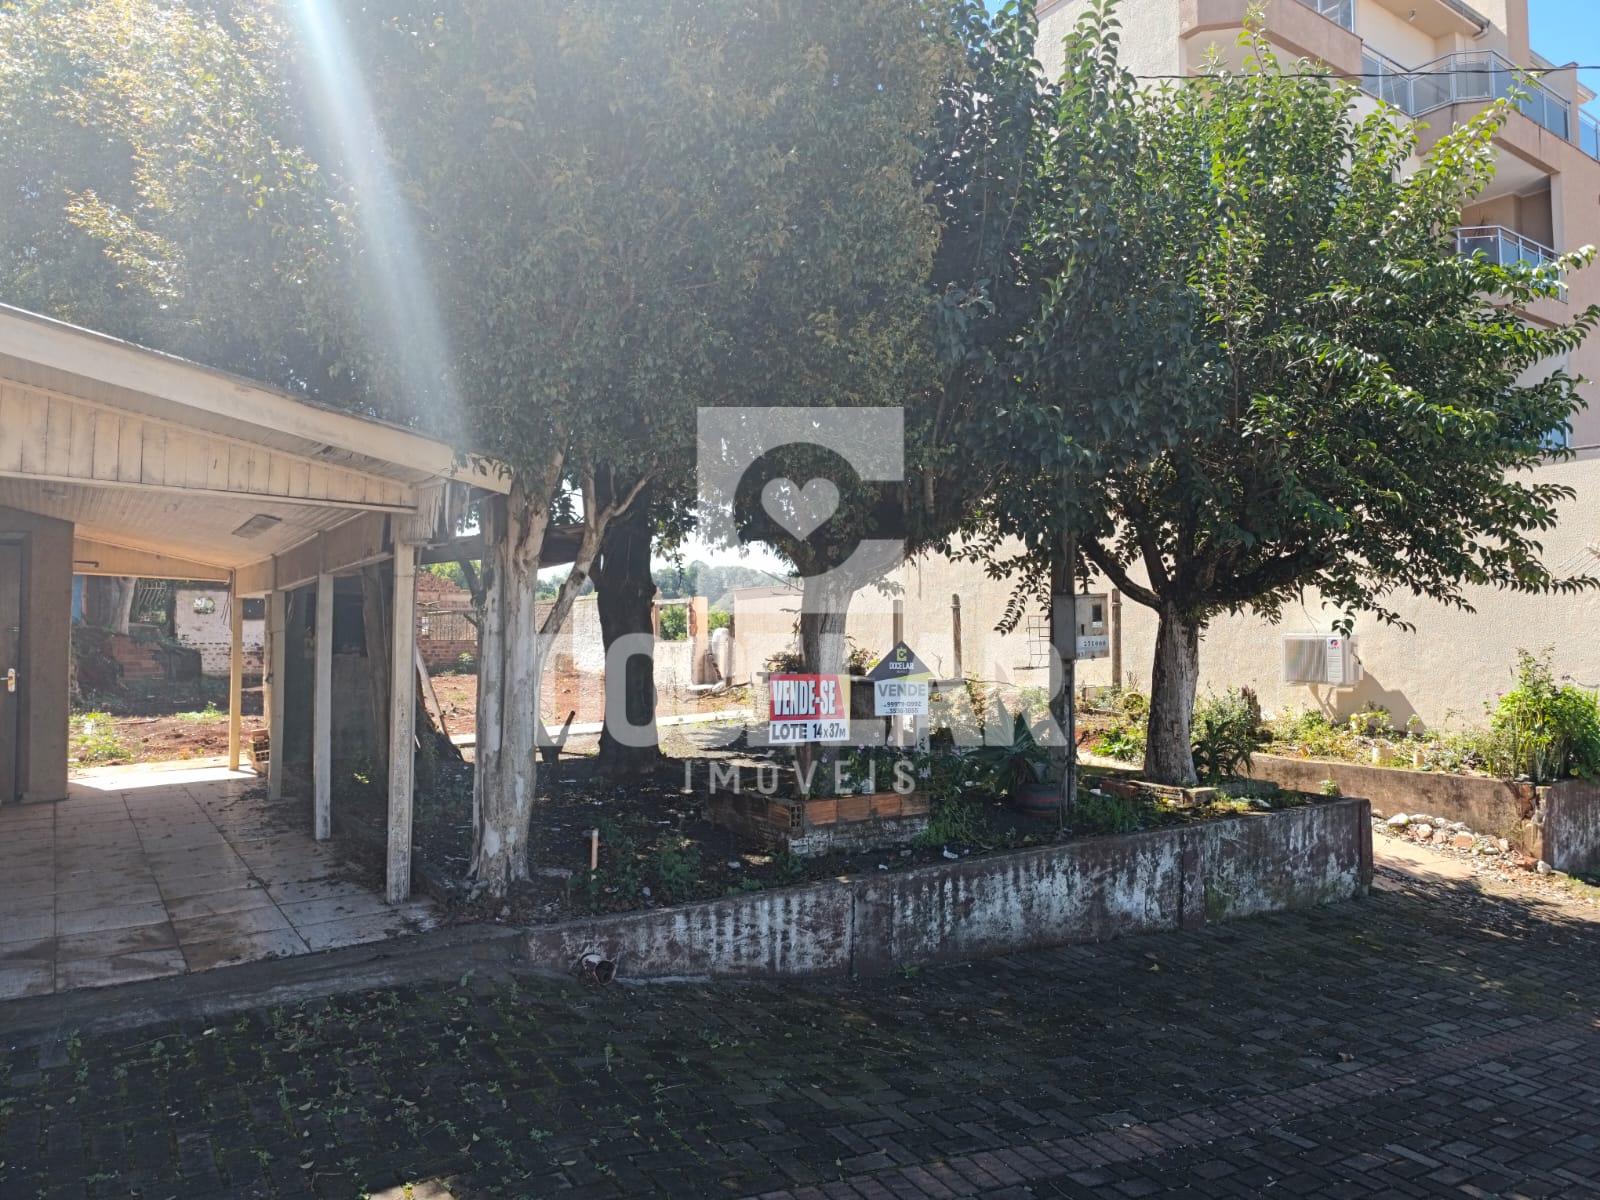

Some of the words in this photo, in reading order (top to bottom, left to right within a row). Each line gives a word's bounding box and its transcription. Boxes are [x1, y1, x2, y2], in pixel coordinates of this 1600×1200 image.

[773, 680, 836, 716] VENDE-SE
[878, 684, 926, 697] VENDE
[772, 723, 807, 740] LOTE
